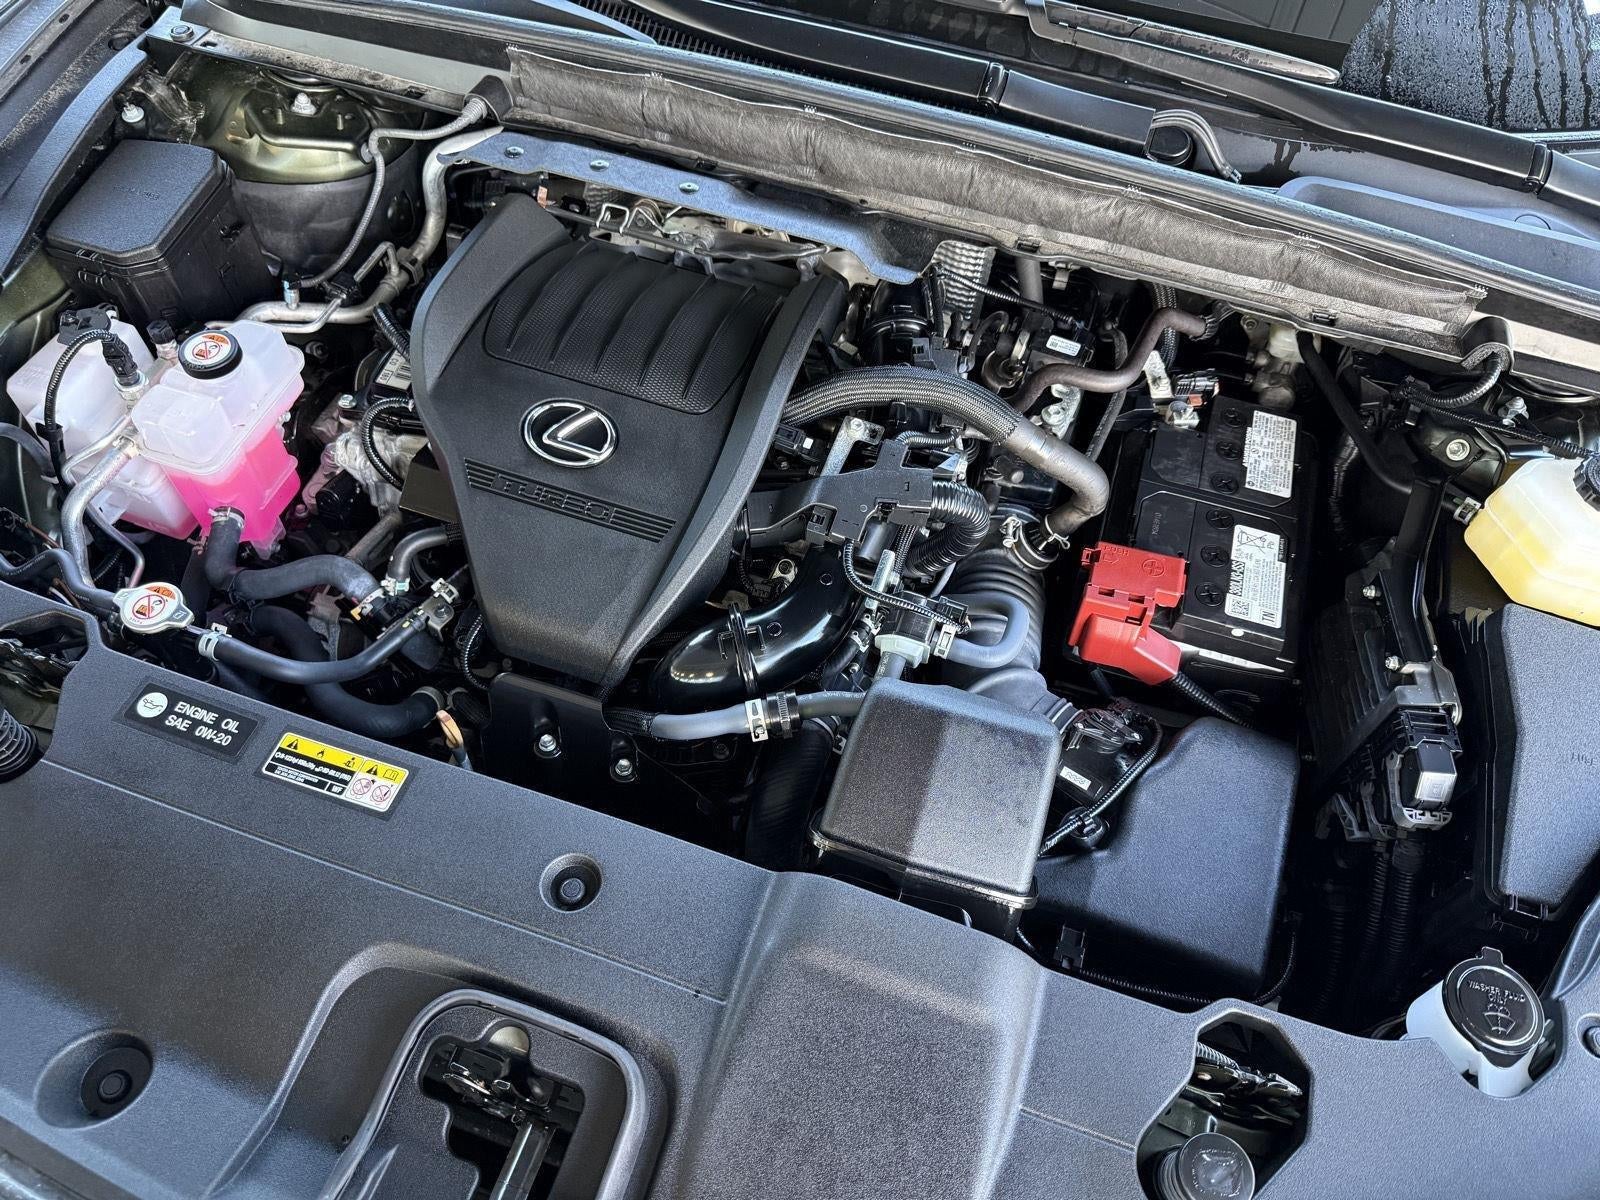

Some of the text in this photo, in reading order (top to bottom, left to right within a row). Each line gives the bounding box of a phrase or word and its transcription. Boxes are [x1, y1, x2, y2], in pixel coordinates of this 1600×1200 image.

[503, 481, 609, 519] TURBO
[165, 714, 232, 746] SAE 0W-20
[174, 701, 241, 733] ENGINE OIL
[1468, 980, 1501, 996] WASHER
